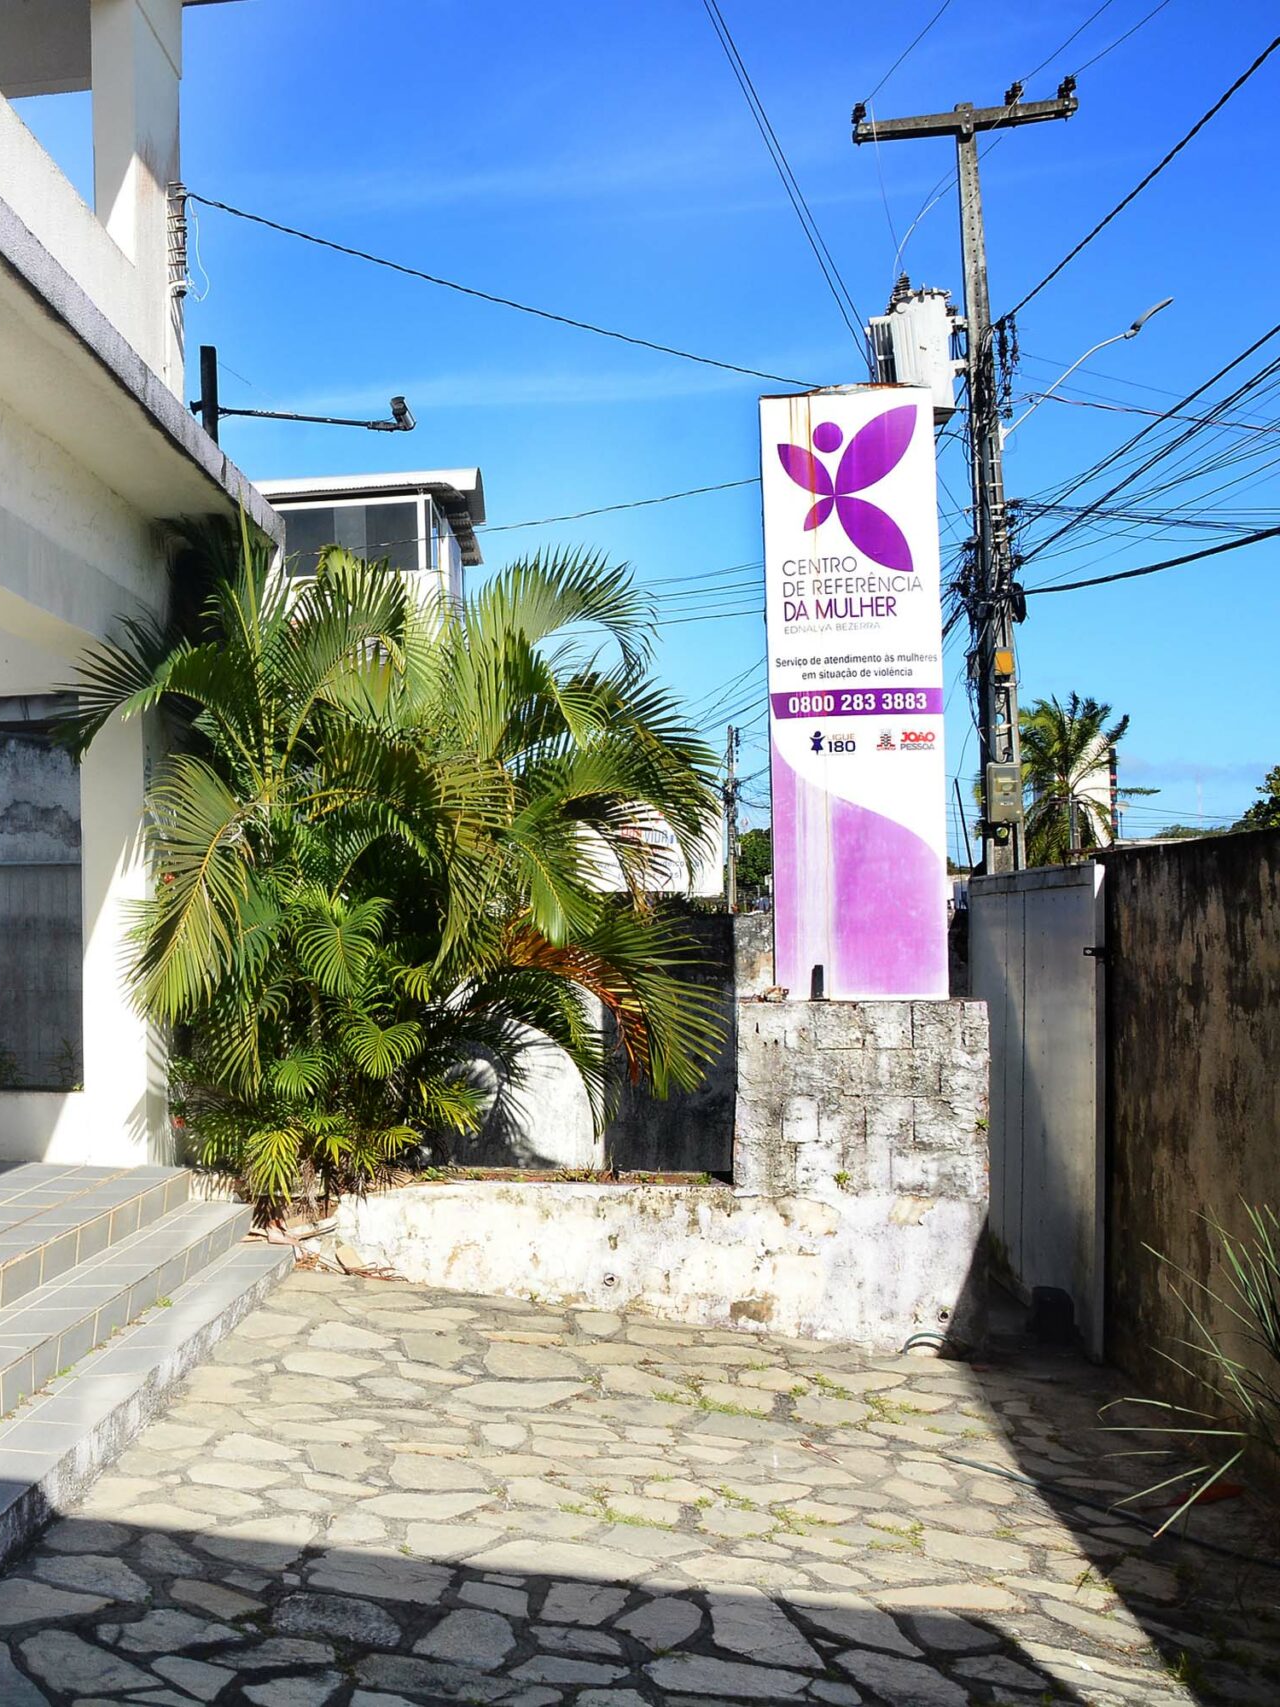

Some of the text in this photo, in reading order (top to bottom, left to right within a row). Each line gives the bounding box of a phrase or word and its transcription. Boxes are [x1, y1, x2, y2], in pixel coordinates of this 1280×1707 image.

[782, 556, 857, 577] CENTRO
[782, 572, 923, 598] DE REFERÊNCIA
[784, 596, 897, 622] DA MULHER
[784, 621, 880, 635] EDNALVA BEZERRA
[775, 656, 808, 669] Serviço
[809, 655, 822, 665] de
[823, 654, 882, 665] atendimento
[896, 652, 938, 663] mulheres
[801, 666, 913, 682] em situação de violência
[788, 692, 927, 714] 0800 283 3883
[827, 733, 855, 741] LIGUE
[900, 731, 935, 743] JOÃO
[827, 740, 856, 753] 180
[900, 743, 935, 751] PESSOA
